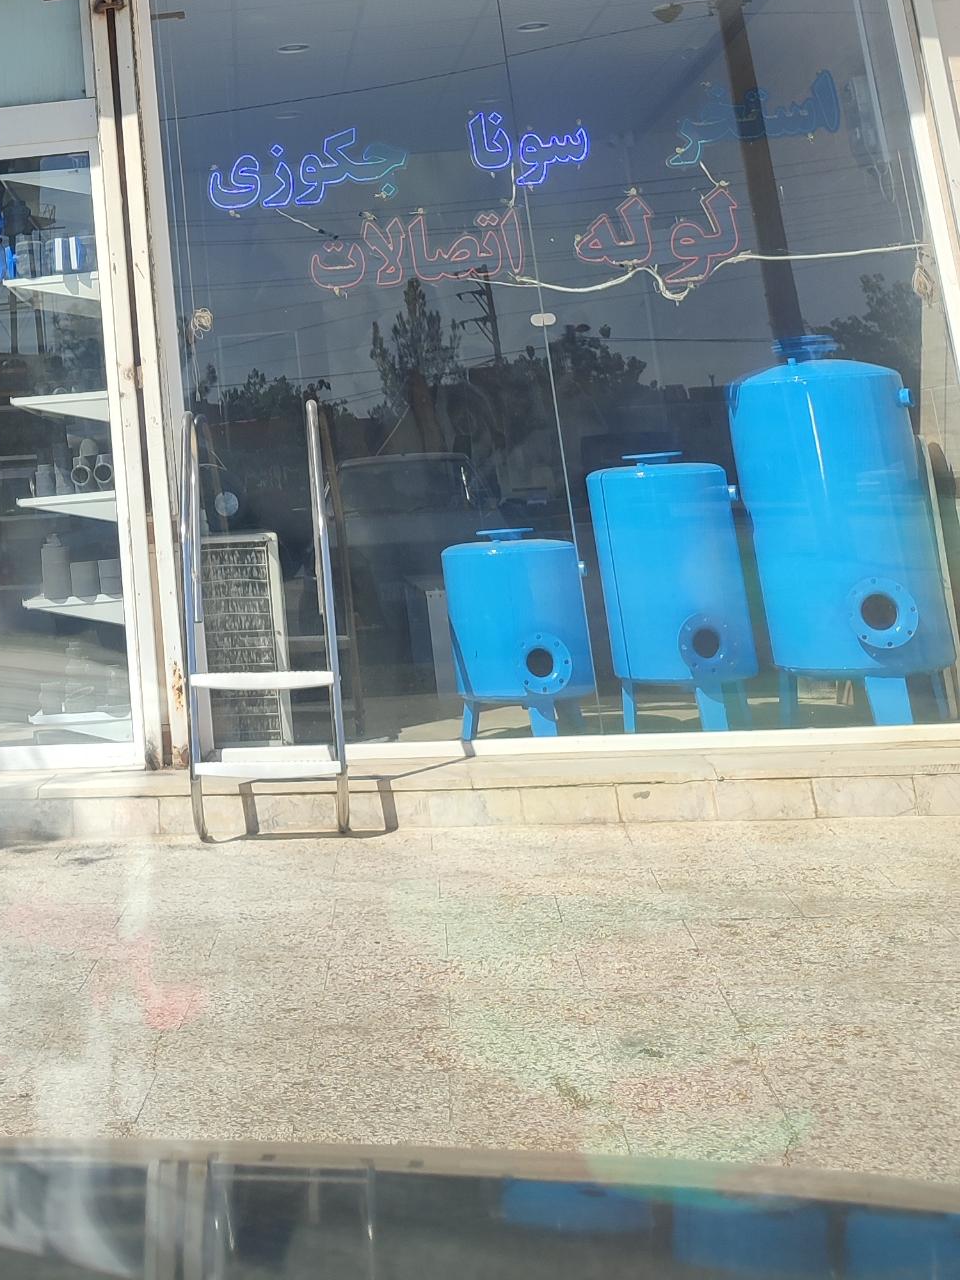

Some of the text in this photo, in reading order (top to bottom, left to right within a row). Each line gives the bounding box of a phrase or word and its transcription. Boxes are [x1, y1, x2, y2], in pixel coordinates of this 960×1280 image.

[209, 127, 408, 209] جکوزی
[468, 111, 589, 186] سونا
[311, 207, 525, 289] اتصالات
